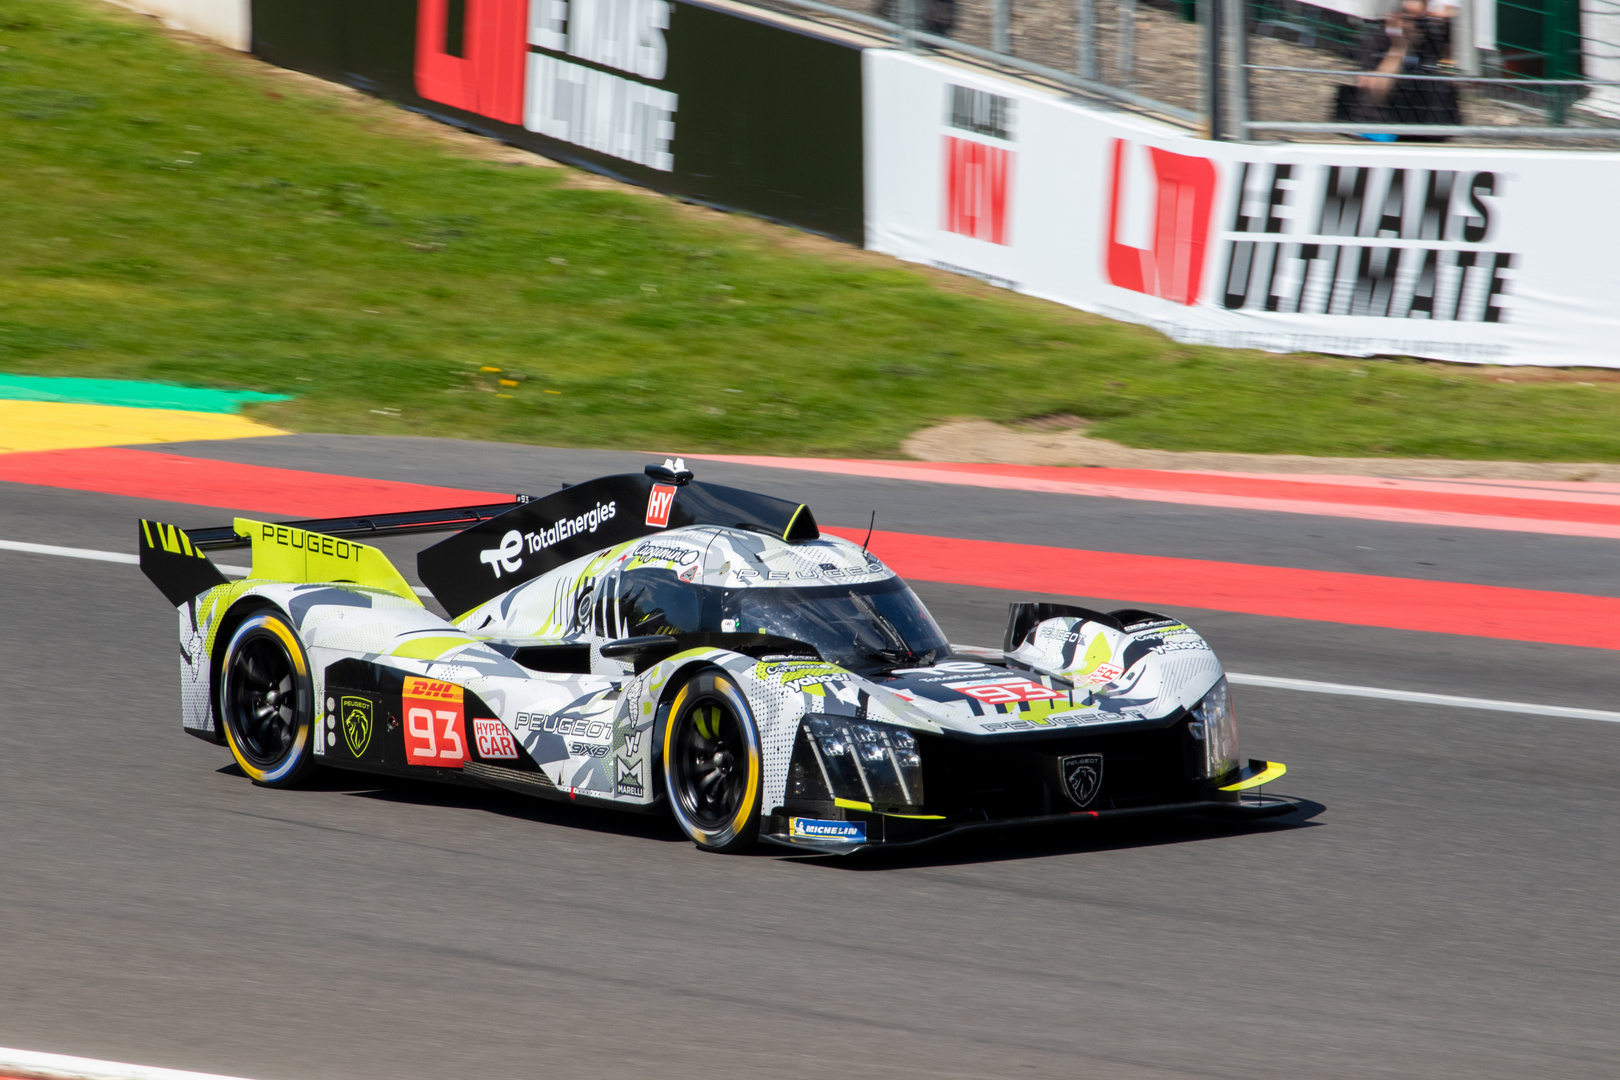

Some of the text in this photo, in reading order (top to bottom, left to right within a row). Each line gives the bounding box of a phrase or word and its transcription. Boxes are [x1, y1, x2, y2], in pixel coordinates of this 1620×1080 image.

[1226, 162, 1503, 243] LE MANS
[1221, 240, 1521, 323] ULTIMATE
[649, 490, 672, 519] HY
[524, 501, 616, 554] TotalEnergies
[262, 524, 364, 562] PEUGEOT
[633, 541, 686, 564] Capgemini
[1039, 626, 1087, 644] PEUGEOT
[411, 681, 455, 698] DHL
[784, 673, 851, 693] yahoo!
[965, 683, 1057, 702] 93
[343, 701, 370, 709] PEUGEOT
[476, 722, 509, 736] HYPER
[515, 712, 613, 740] PEUGEOT
[980, 710, 1142, 732] PEUGEOT
[408, 707, 464, 759] 93
[479, 736, 514, 756] CAR
[1066, 758, 1099, 766] PEUGEOT
[618, 784, 643, 796] MARELLI
[805, 825, 857, 835] MICHELIN
